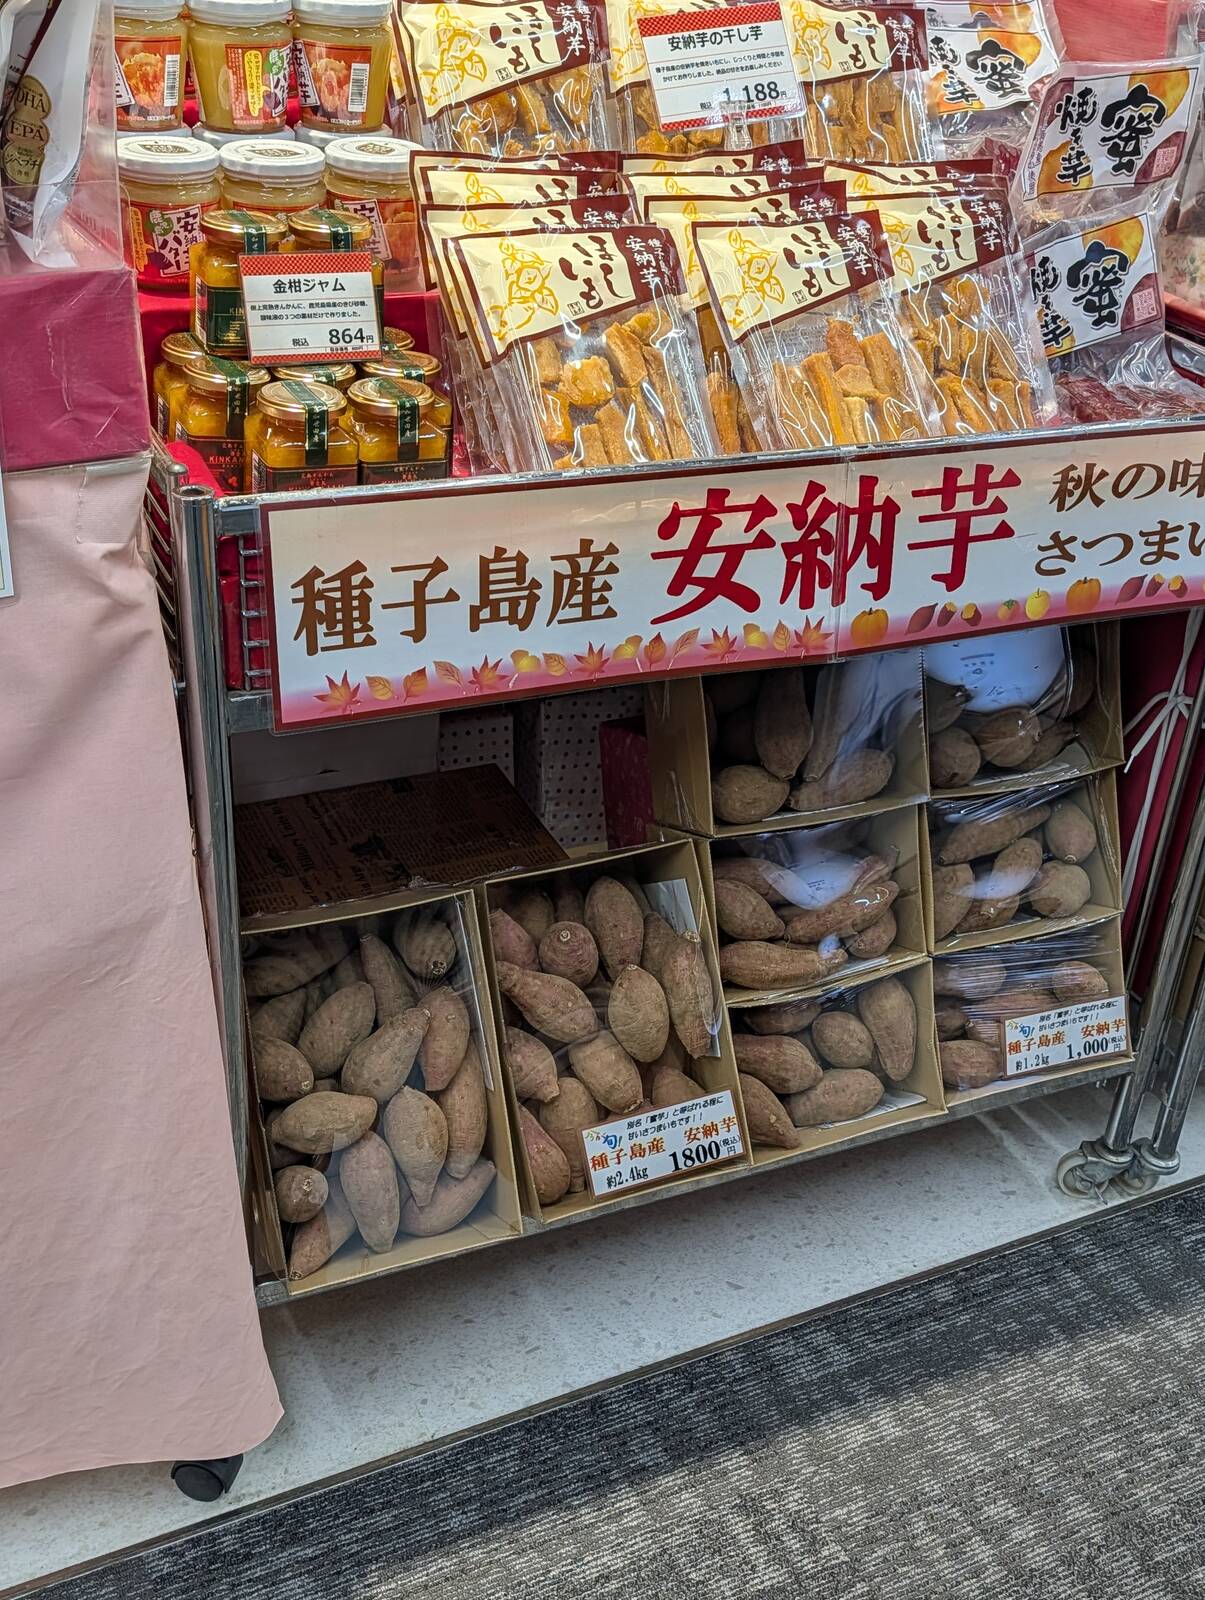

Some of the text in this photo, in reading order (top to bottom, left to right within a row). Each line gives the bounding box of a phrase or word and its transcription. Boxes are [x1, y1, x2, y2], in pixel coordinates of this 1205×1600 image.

[668, 25, 763, 51] 安納芋の干し芋
[10, 120, 44, 142] EPA
[1101, 84, 1166, 173] 蜜
[272, 278, 346, 294] 金柑ジャム
[626, 236, 661, 289] 安納芋
[1067, 241, 1129, 327] 蜜
[292, 327, 375, 347] 税込 864円
[291, 538, 620, 656] 種子島産
[650, 463, 1022, 625] 安納芋
[1007, 1018, 1126, 1056] 種子島産 安納芋
[590, 1115, 736, 1172] 種子島産 安納芋
[606, 1165, 649, 1190] 約2.4kg
[669, 1140, 721, 1174] 1800
